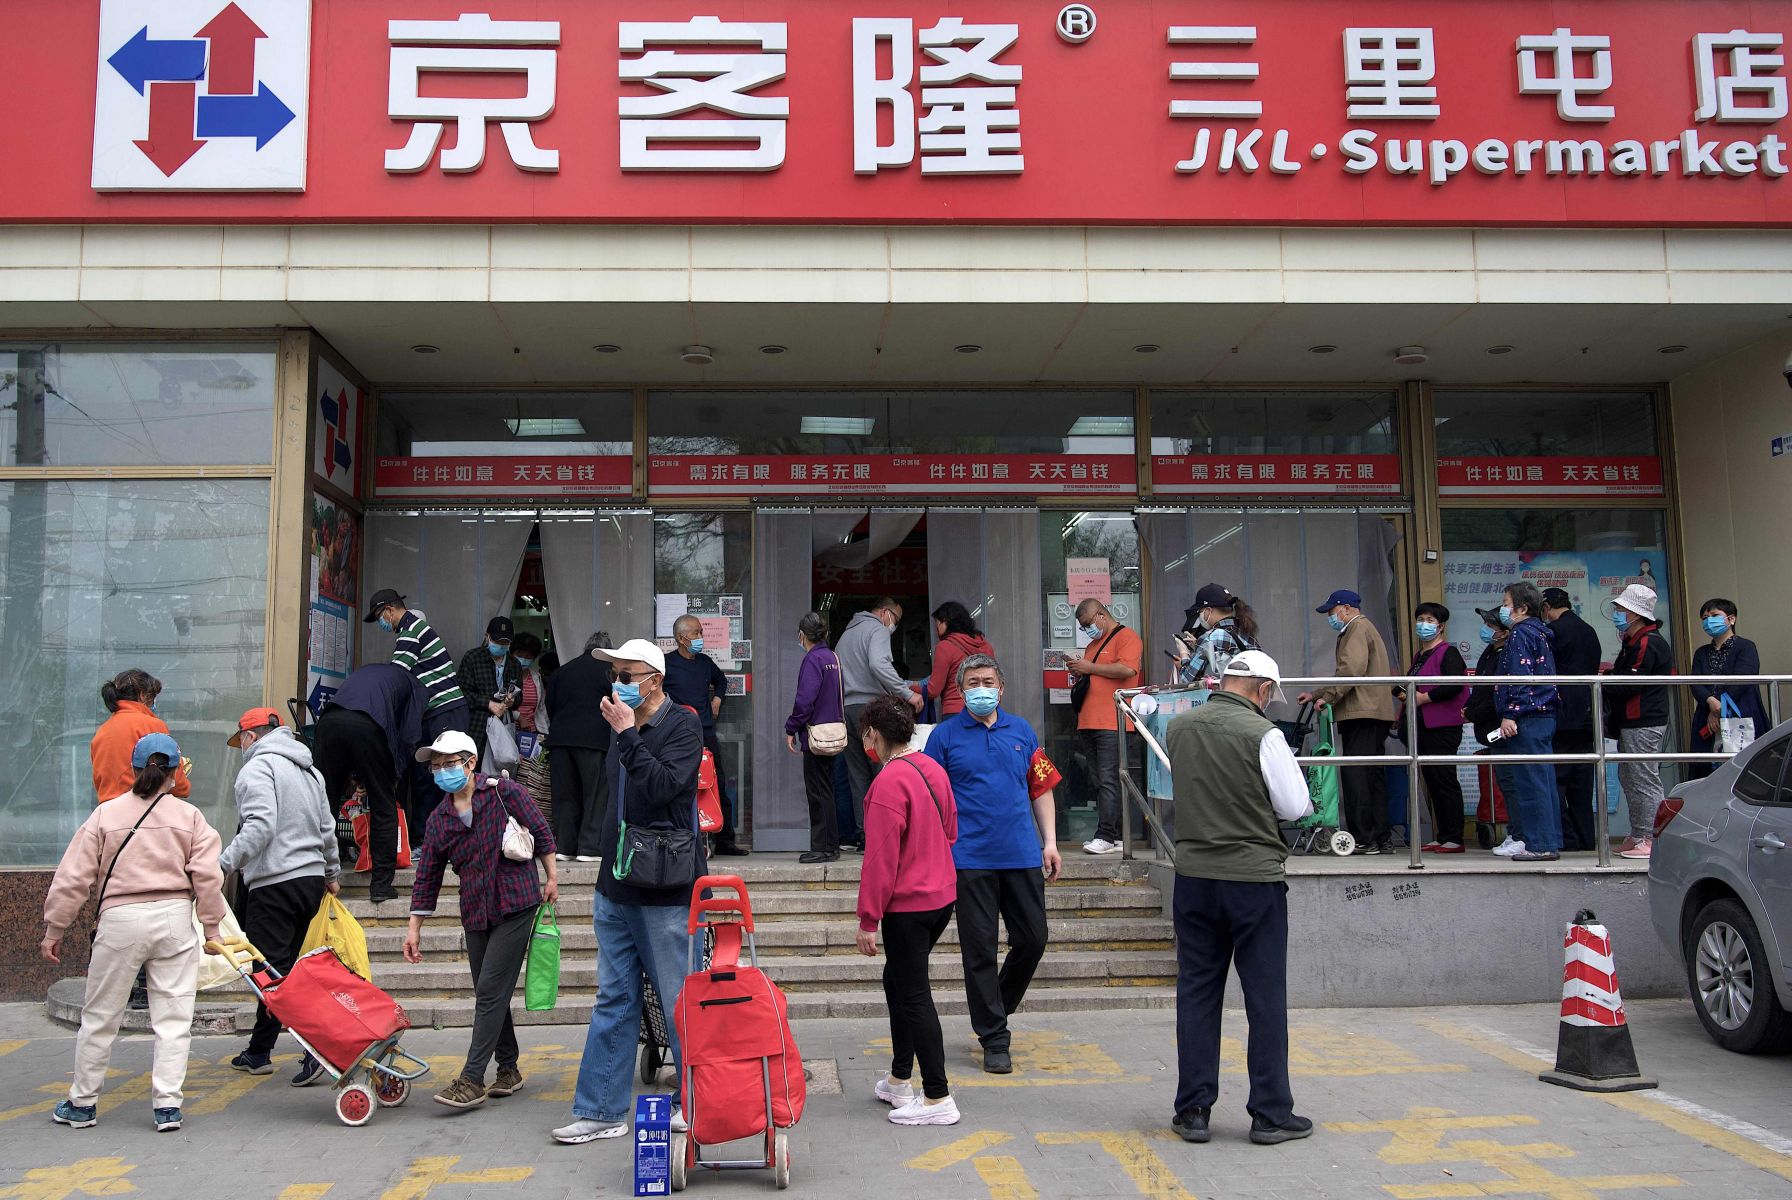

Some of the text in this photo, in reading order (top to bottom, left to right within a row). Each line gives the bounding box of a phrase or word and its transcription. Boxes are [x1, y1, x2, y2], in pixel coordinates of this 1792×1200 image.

[1167, 27, 1788, 123] 三里屯店
[384, 13, 1024, 176] 京客隆
[412, 465, 595, 482] 件件如意 天天省钱
[929, 463, 1109, 479] 件件如意 天天省钱
[1466, 465, 1640, 481] 件件如意 天天省钱
[1444, 562, 1516, 575] 共享无烟生活
[1444, 581, 1513, 595] 共创健康北
[1033, 757, 1054, 781] 安全
